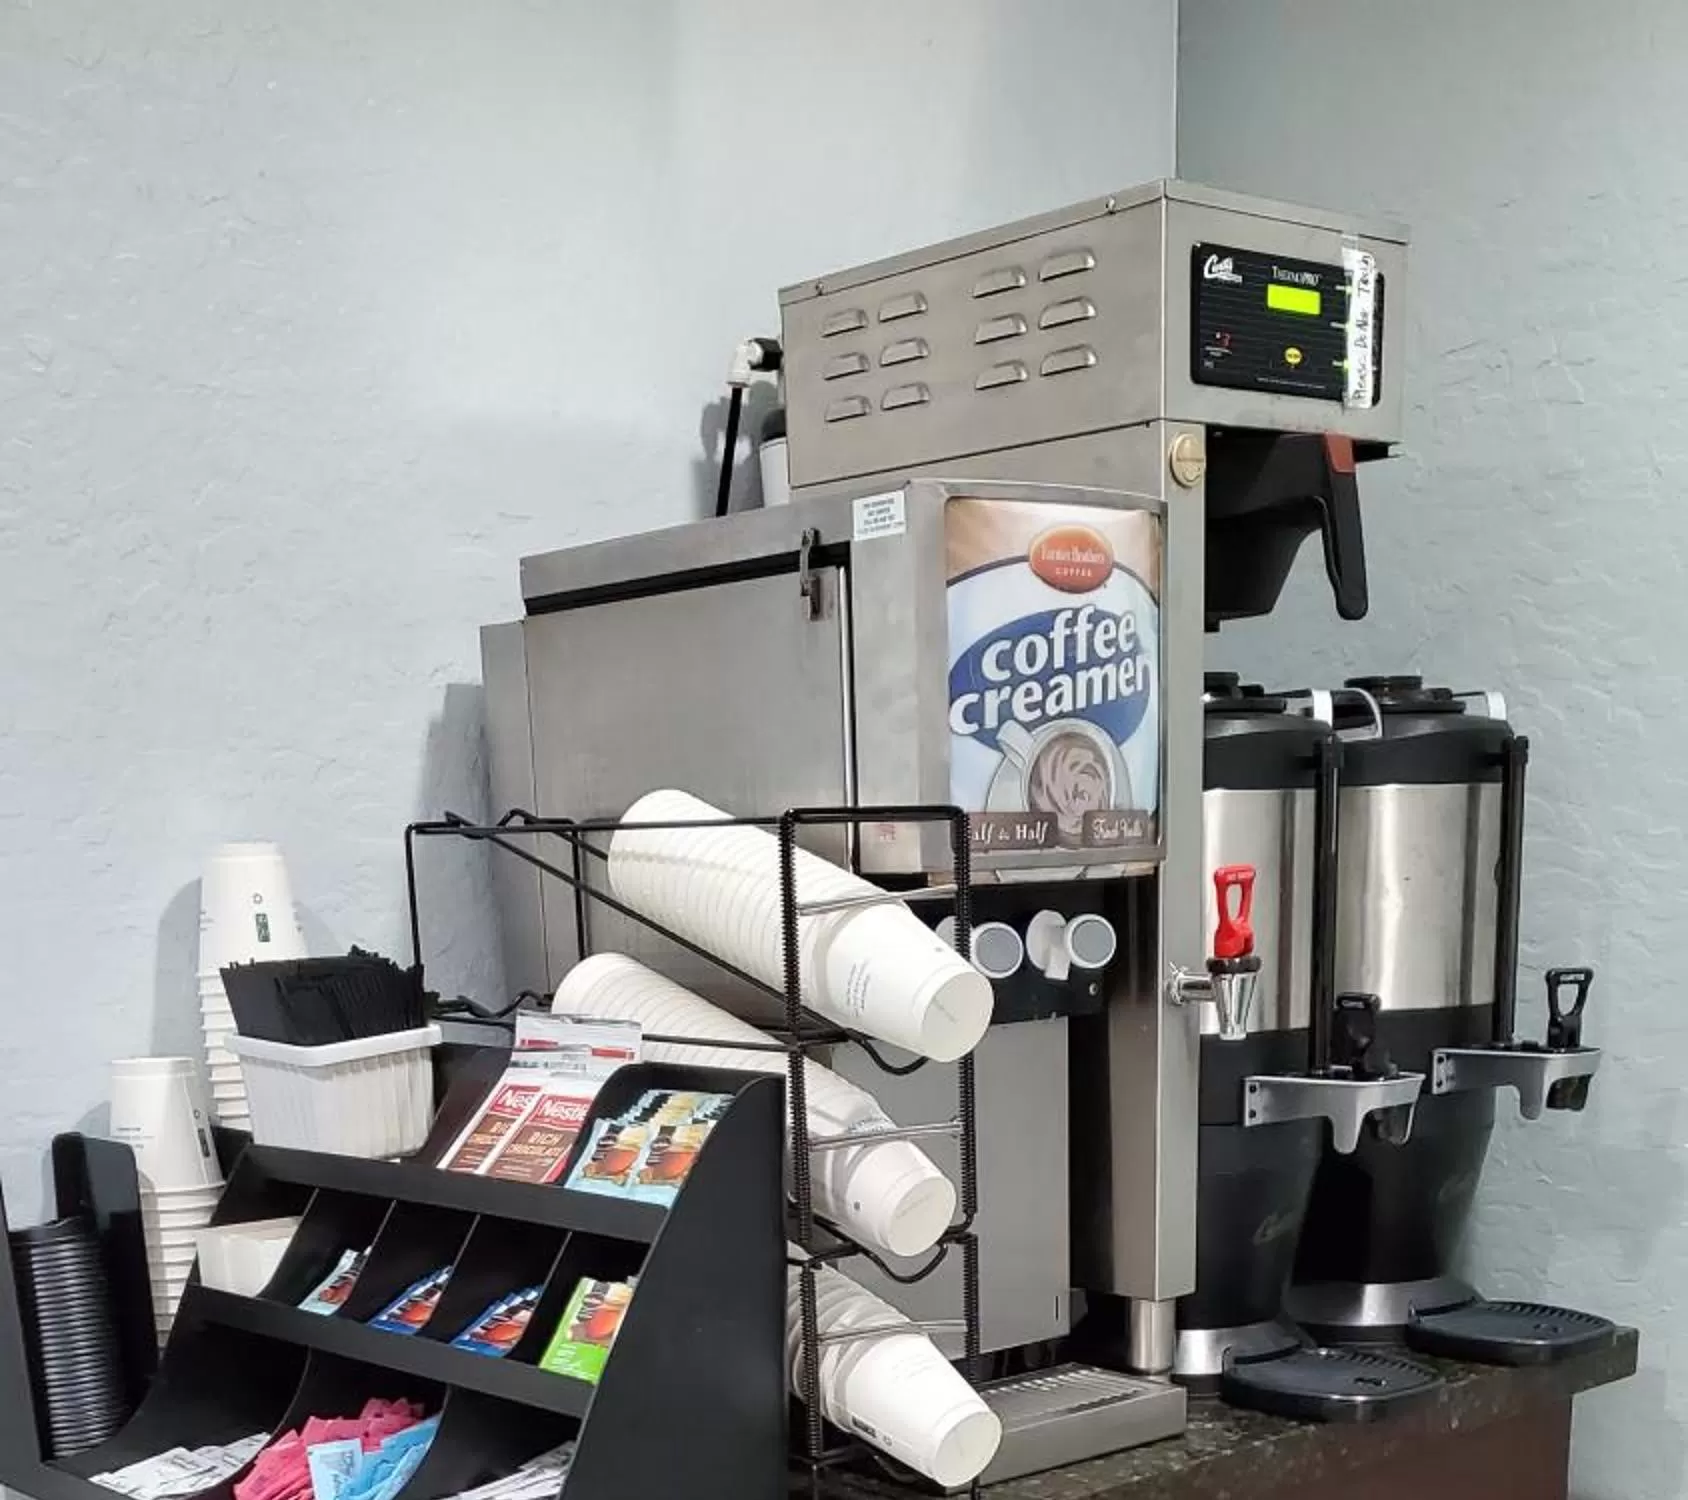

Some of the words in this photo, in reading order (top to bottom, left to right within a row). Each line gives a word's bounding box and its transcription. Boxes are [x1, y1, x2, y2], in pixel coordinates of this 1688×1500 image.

[981, 604, 1137, 682] coffee
[949, 652, 1158, 735] creamer
[968, 823, 995, 845] alf
[1015, 820, 1049, 845] Half
